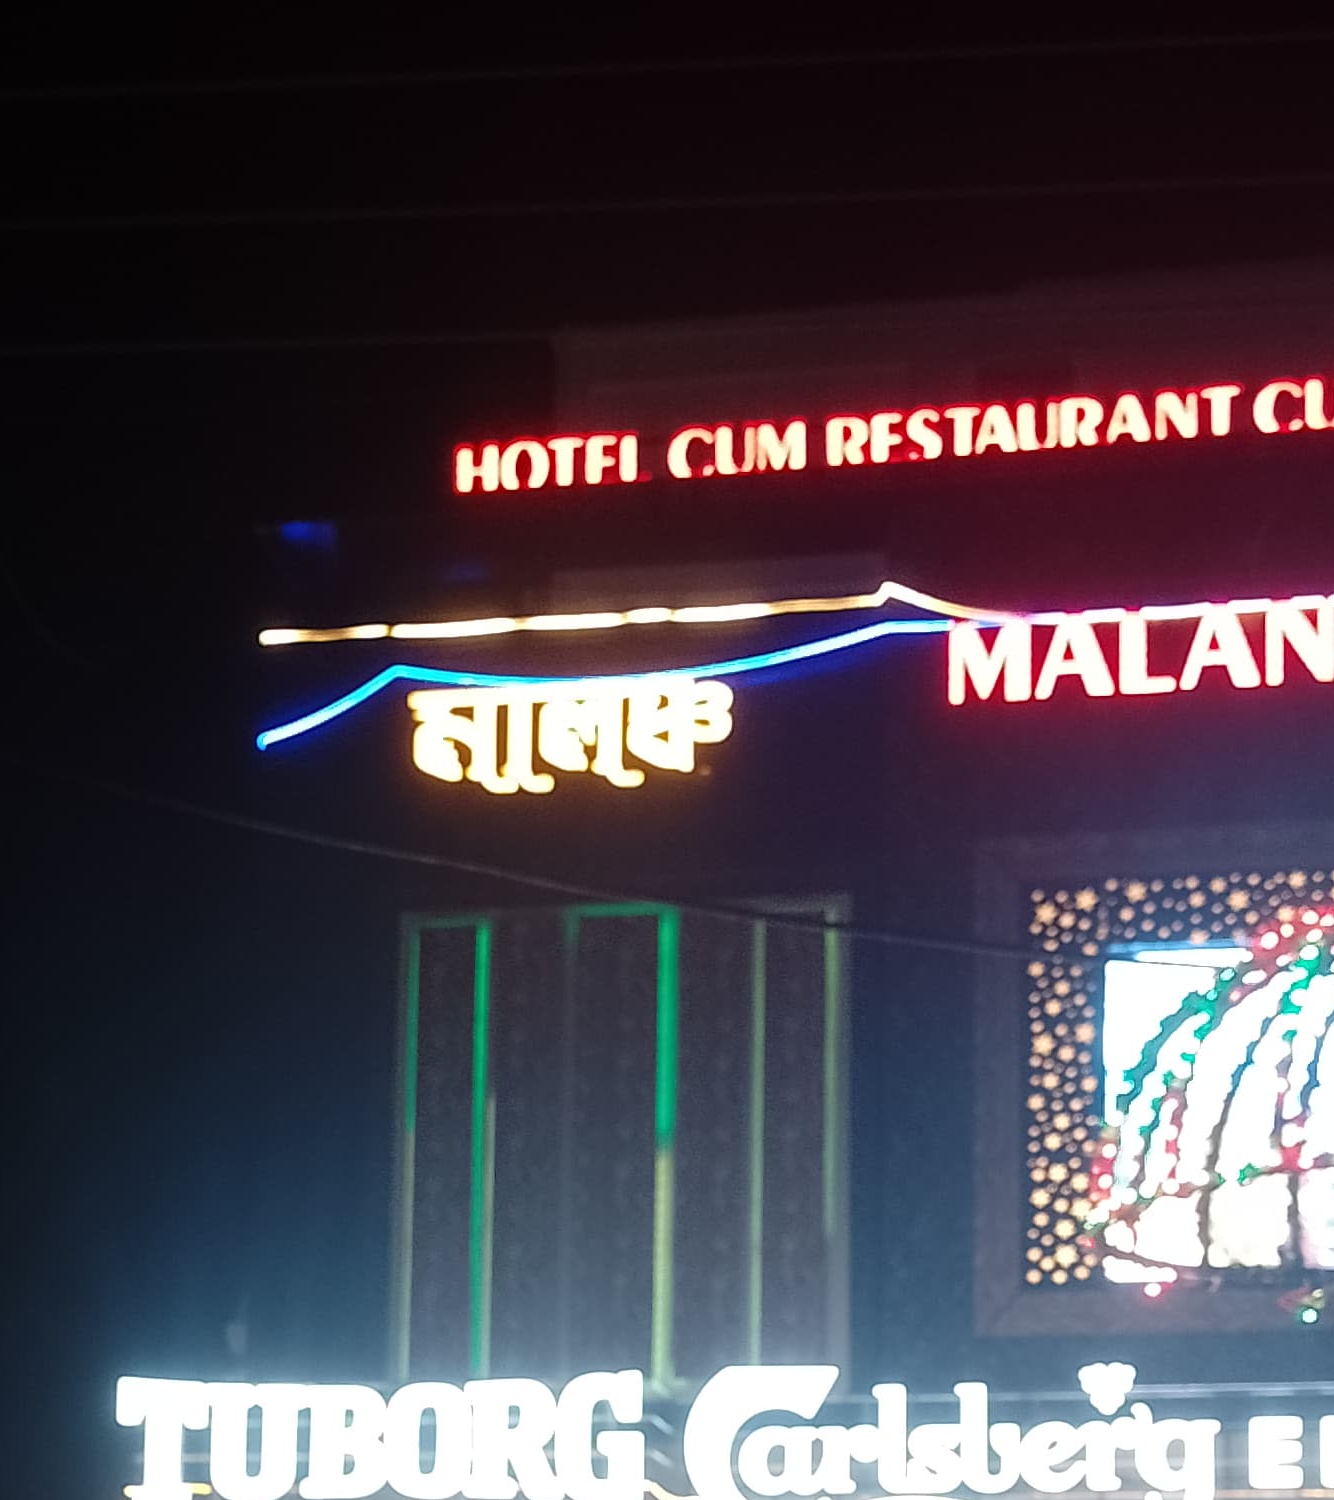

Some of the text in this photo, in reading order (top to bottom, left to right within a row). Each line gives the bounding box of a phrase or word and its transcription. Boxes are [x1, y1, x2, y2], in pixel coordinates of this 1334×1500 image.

[454, 434, 651, 493] HOTEL
[666, 419, 808, 479] CUM
[824, 383, 1244, 467] RESTAURANT
